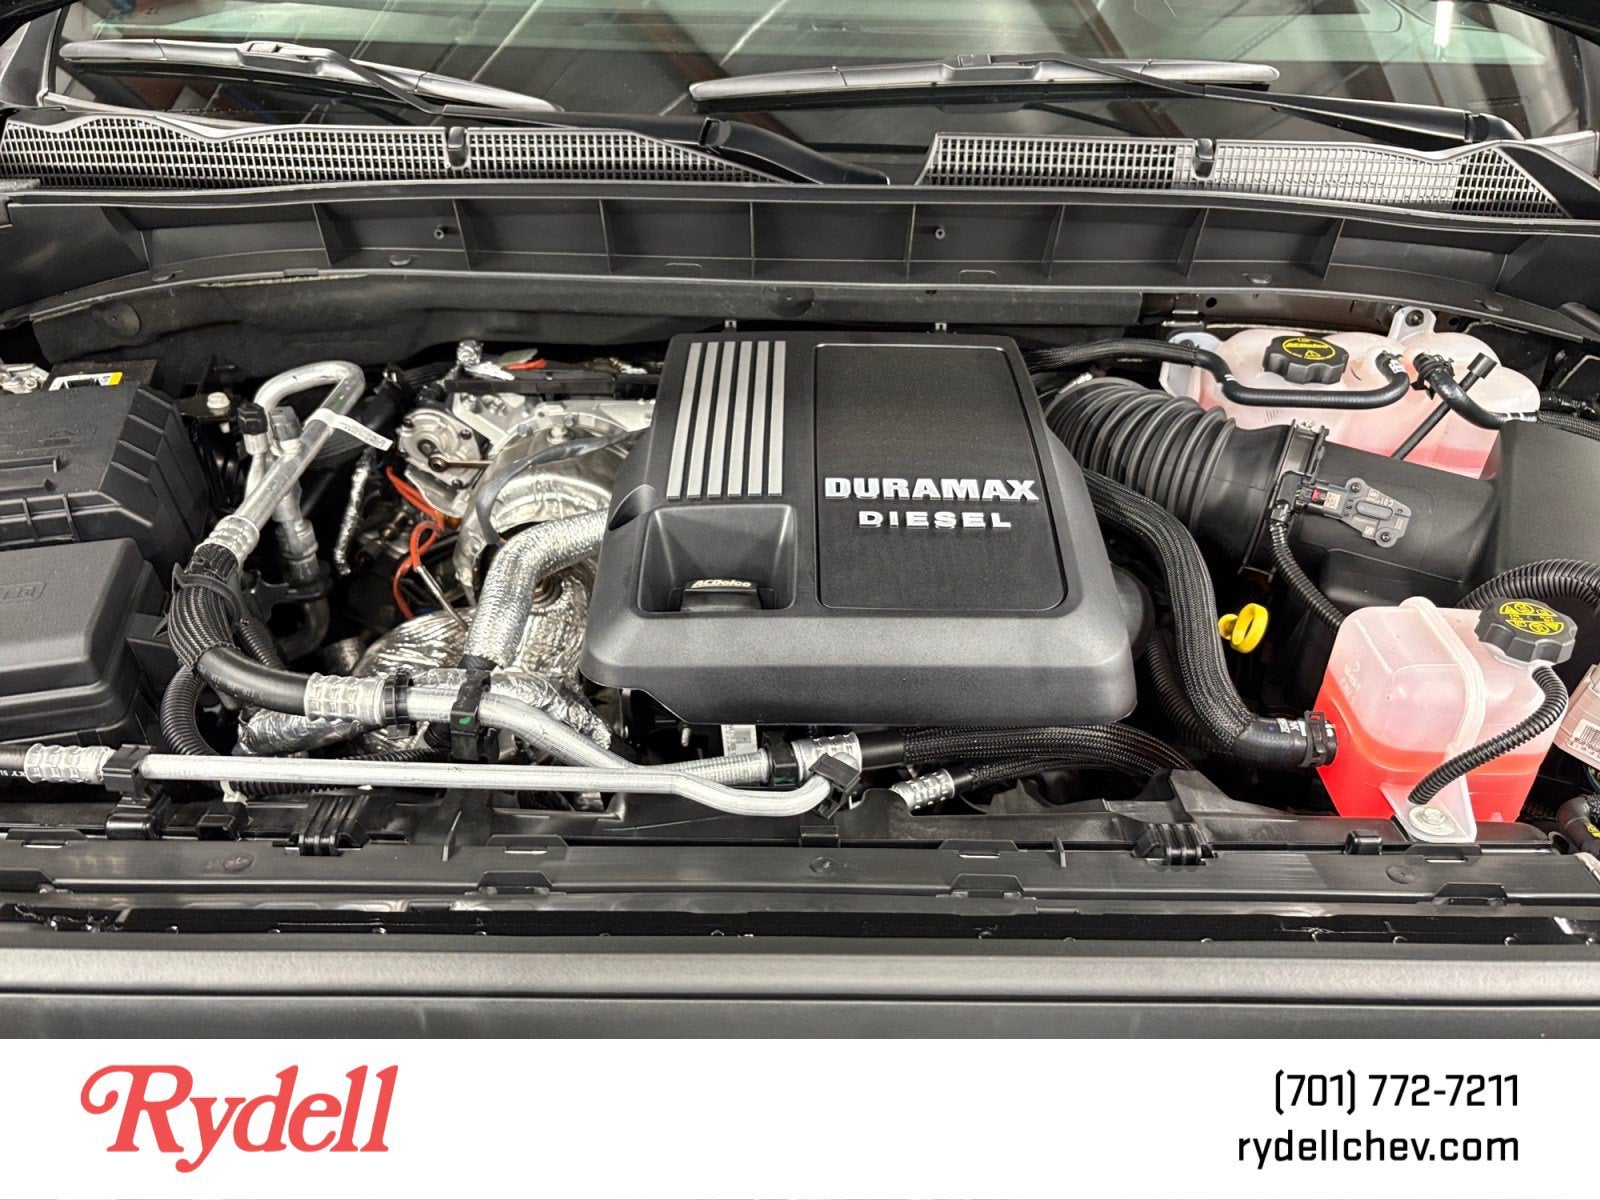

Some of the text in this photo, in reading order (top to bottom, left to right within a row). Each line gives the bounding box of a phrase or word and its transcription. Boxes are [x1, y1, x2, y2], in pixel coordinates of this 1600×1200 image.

[825, 478, 1039, 502] DURAMAX
[859, 511, 1012, 530] DIESEL
[691, 579, 752, 588] ACDelco
